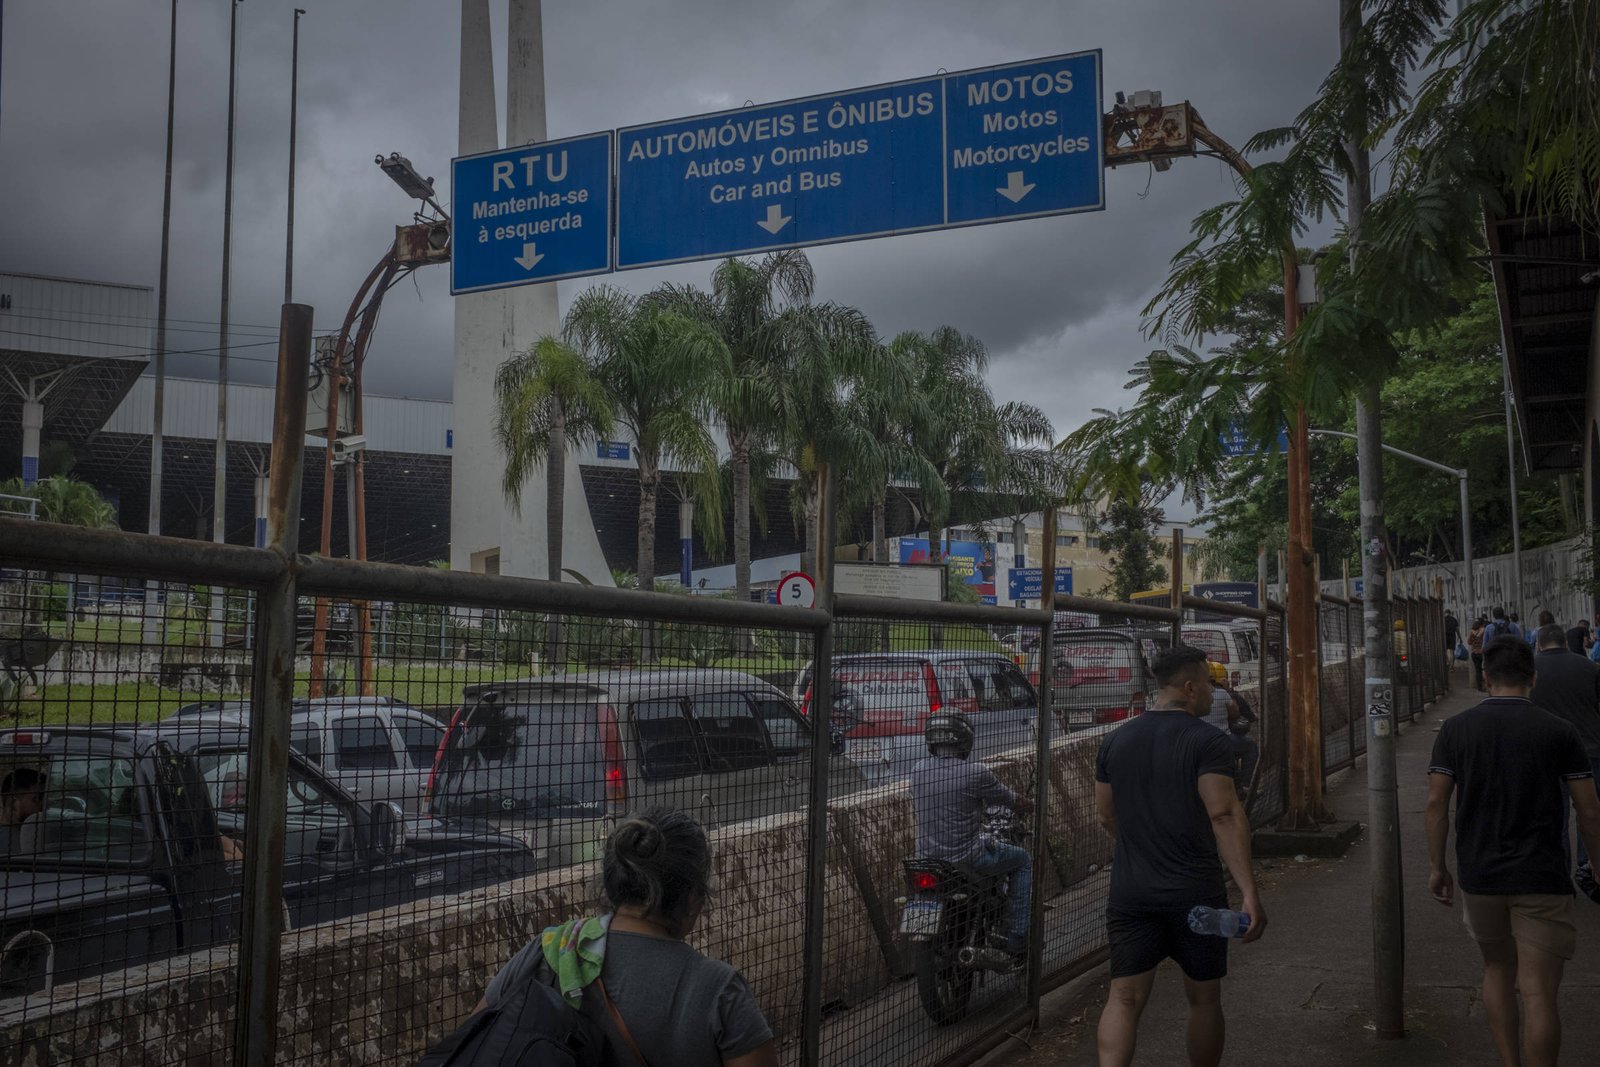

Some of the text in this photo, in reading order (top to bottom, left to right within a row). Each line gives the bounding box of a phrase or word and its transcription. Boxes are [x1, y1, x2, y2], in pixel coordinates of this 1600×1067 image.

[967, 69, 1073, 107] MOTOS
[627, 91, 934, 162] AUTOMÓVEIS E ÔNIBUS
[982, 109, 1058, 134] Motos
[684, 137, 870, 181] Autos y Omnibus
[953, 135, 1091, 170] Motorcycles
[492, 150, 569, 192] RTU
[710, 171, 842, 204] Car and Bus
[472, 188, 589, 220] Mantenha-se
[478, 212, 583, 243] à esquerda
[791, 583, 802, 599] 5
